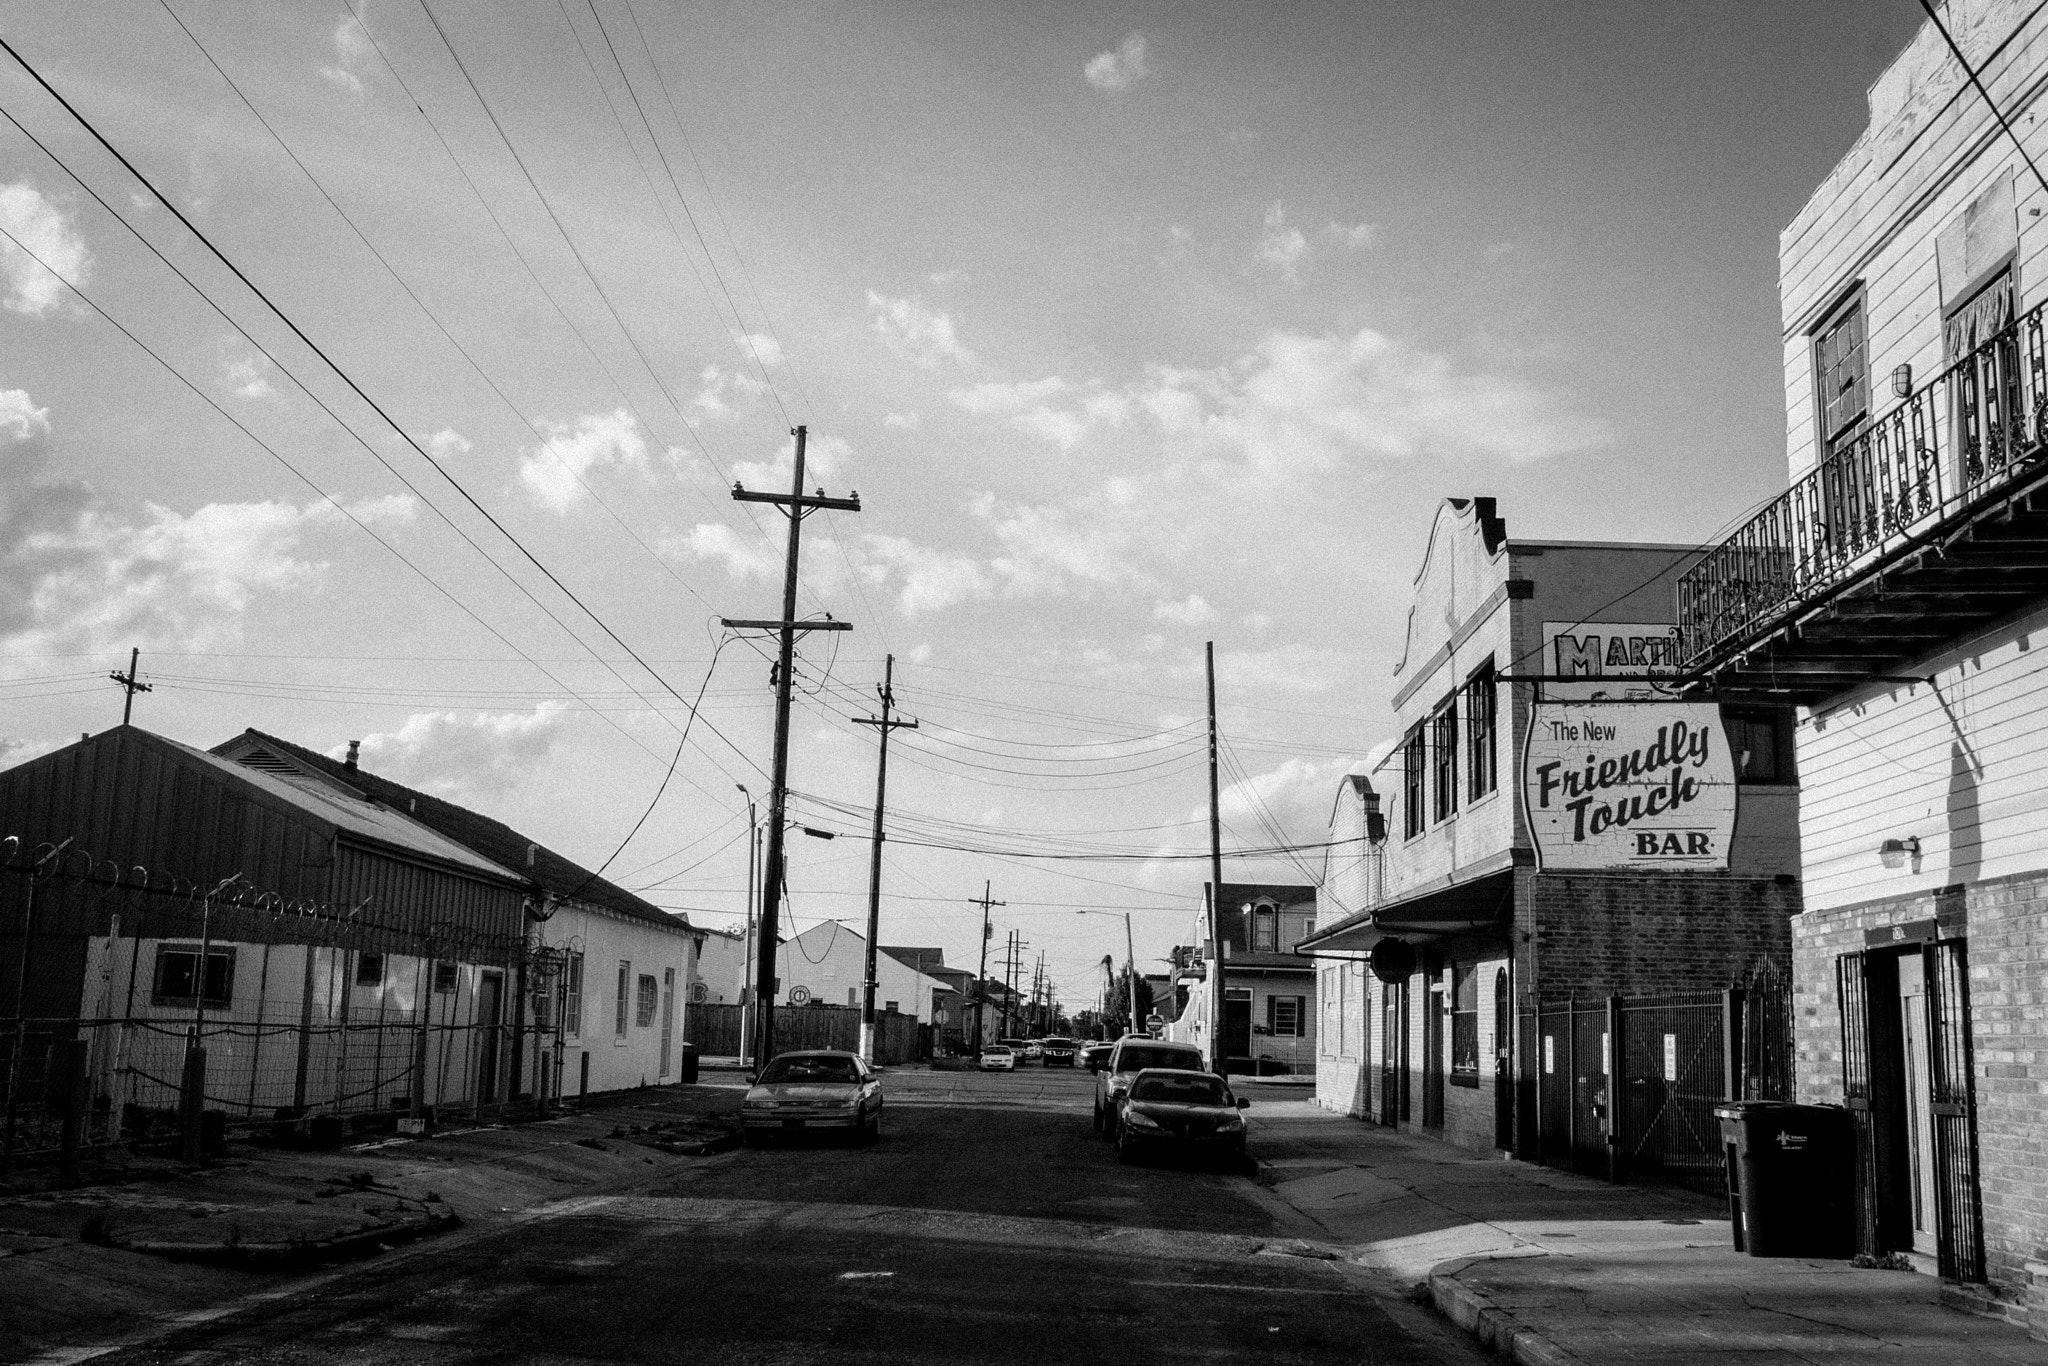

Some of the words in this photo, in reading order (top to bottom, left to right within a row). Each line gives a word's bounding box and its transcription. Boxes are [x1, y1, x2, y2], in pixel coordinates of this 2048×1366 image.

[1551, 720, 1579, 741] The
[1583, 720, 1616, 741] New
[1536, 720, 1709, 808] Friendly
[1566, 766, 1700, 842] Touch
[1636, 832, 1711, 855] BAR
